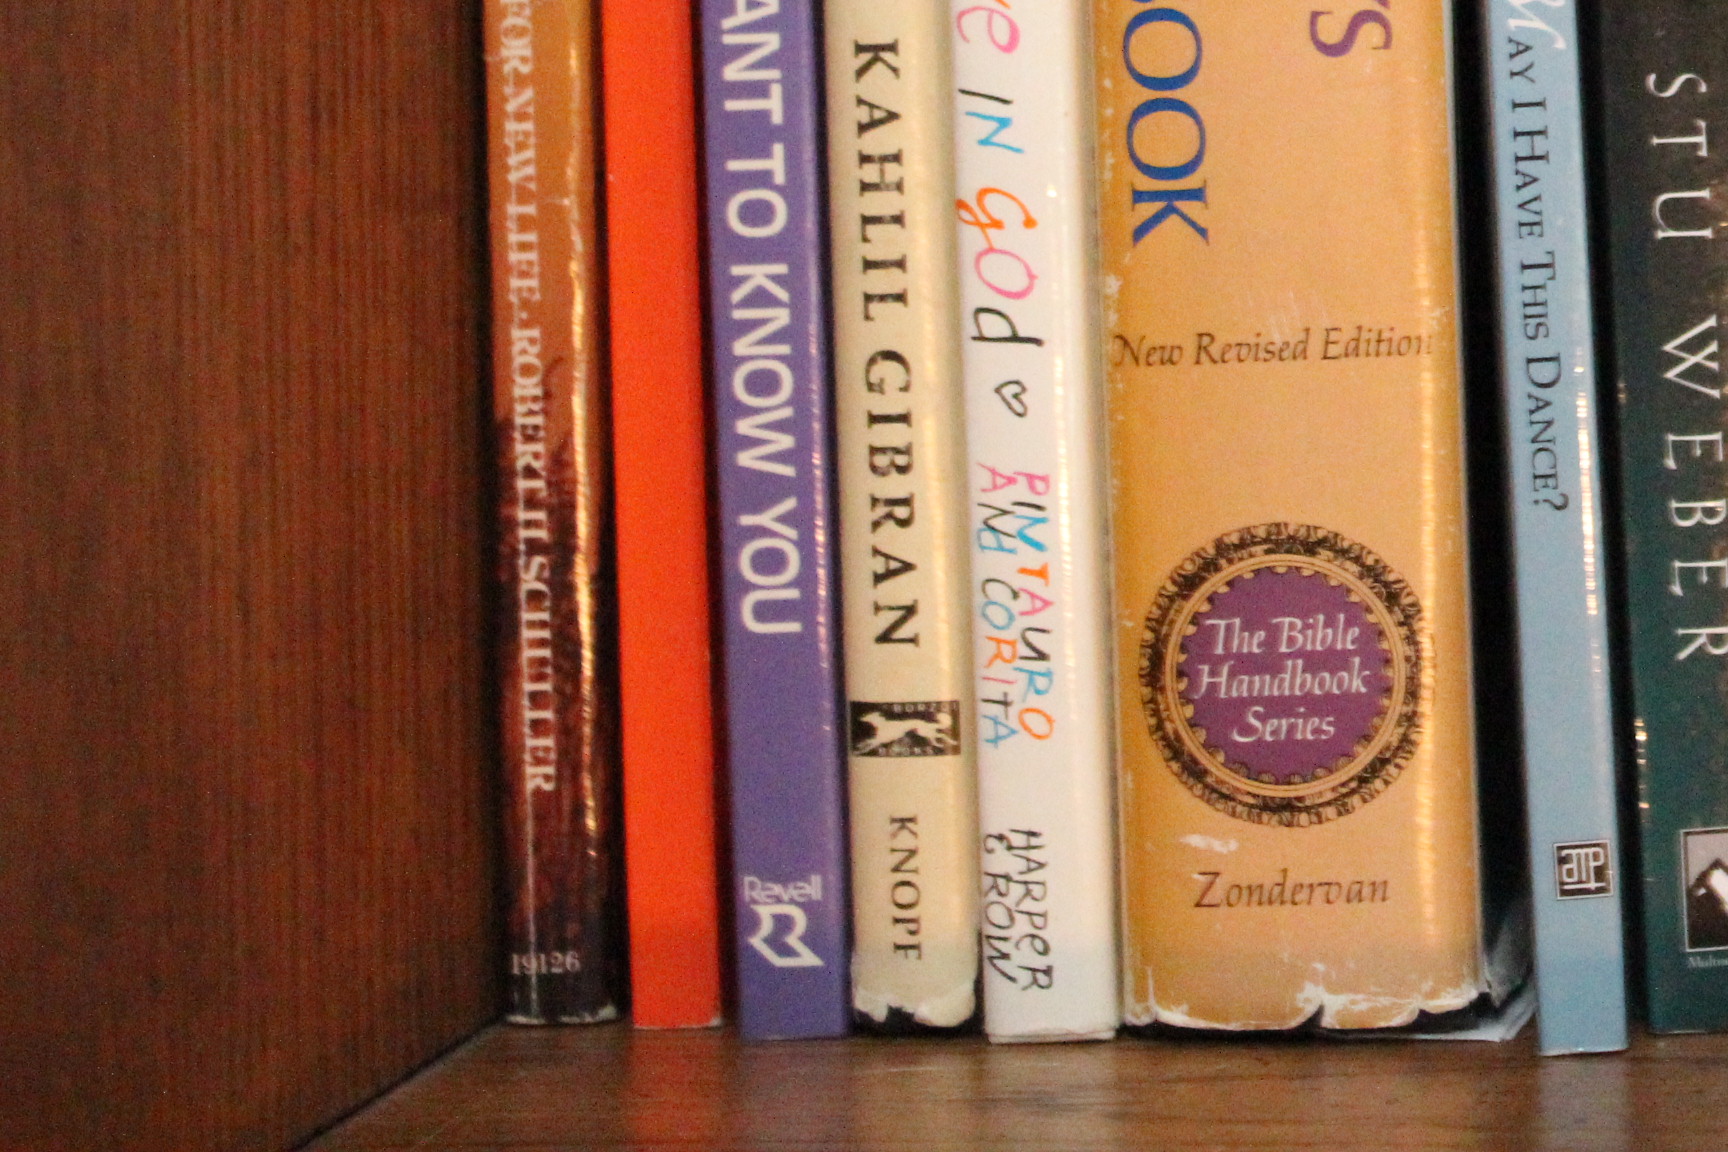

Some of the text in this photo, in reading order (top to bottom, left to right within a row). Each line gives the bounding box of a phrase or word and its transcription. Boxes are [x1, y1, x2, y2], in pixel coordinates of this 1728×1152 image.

[505, 84, 537, 191] NEW
[958, 89, 1025, 154] IN
[1510, 98, 1548, 112] I
[725, 142, 788, 239] TO
[1511, 127, 1550, 240] HAVE
[1646, 71, 1714, 240] STU
[506, 203, 540, 302] LIFE
[1518, 251, 1557, 342] THIS
[730, 262, 797, 478] KNOW
[854, 38, 920, 648] KAHLIL GIBRAN
[1113, 325, 1434, 368] New Revised Edition
[512, 327, 547, 495] ROBERT
[738, 498, 803, 635] YOU
[524, 553, 556, 791] SCHULLER
[1195, 656, 1370, 700] Handbook
[1204, 612, 1360, 655] The Bible
[1231, 706, 1336, 743] Series
[742, 875, 822, 903] Revell
[888, 813, 922, 960] KNOPF
[982, 871, 1017, 984] ROW
[1192, 868, 1392, 909] Zondervan
[511, 951, 581, 975] 19126
